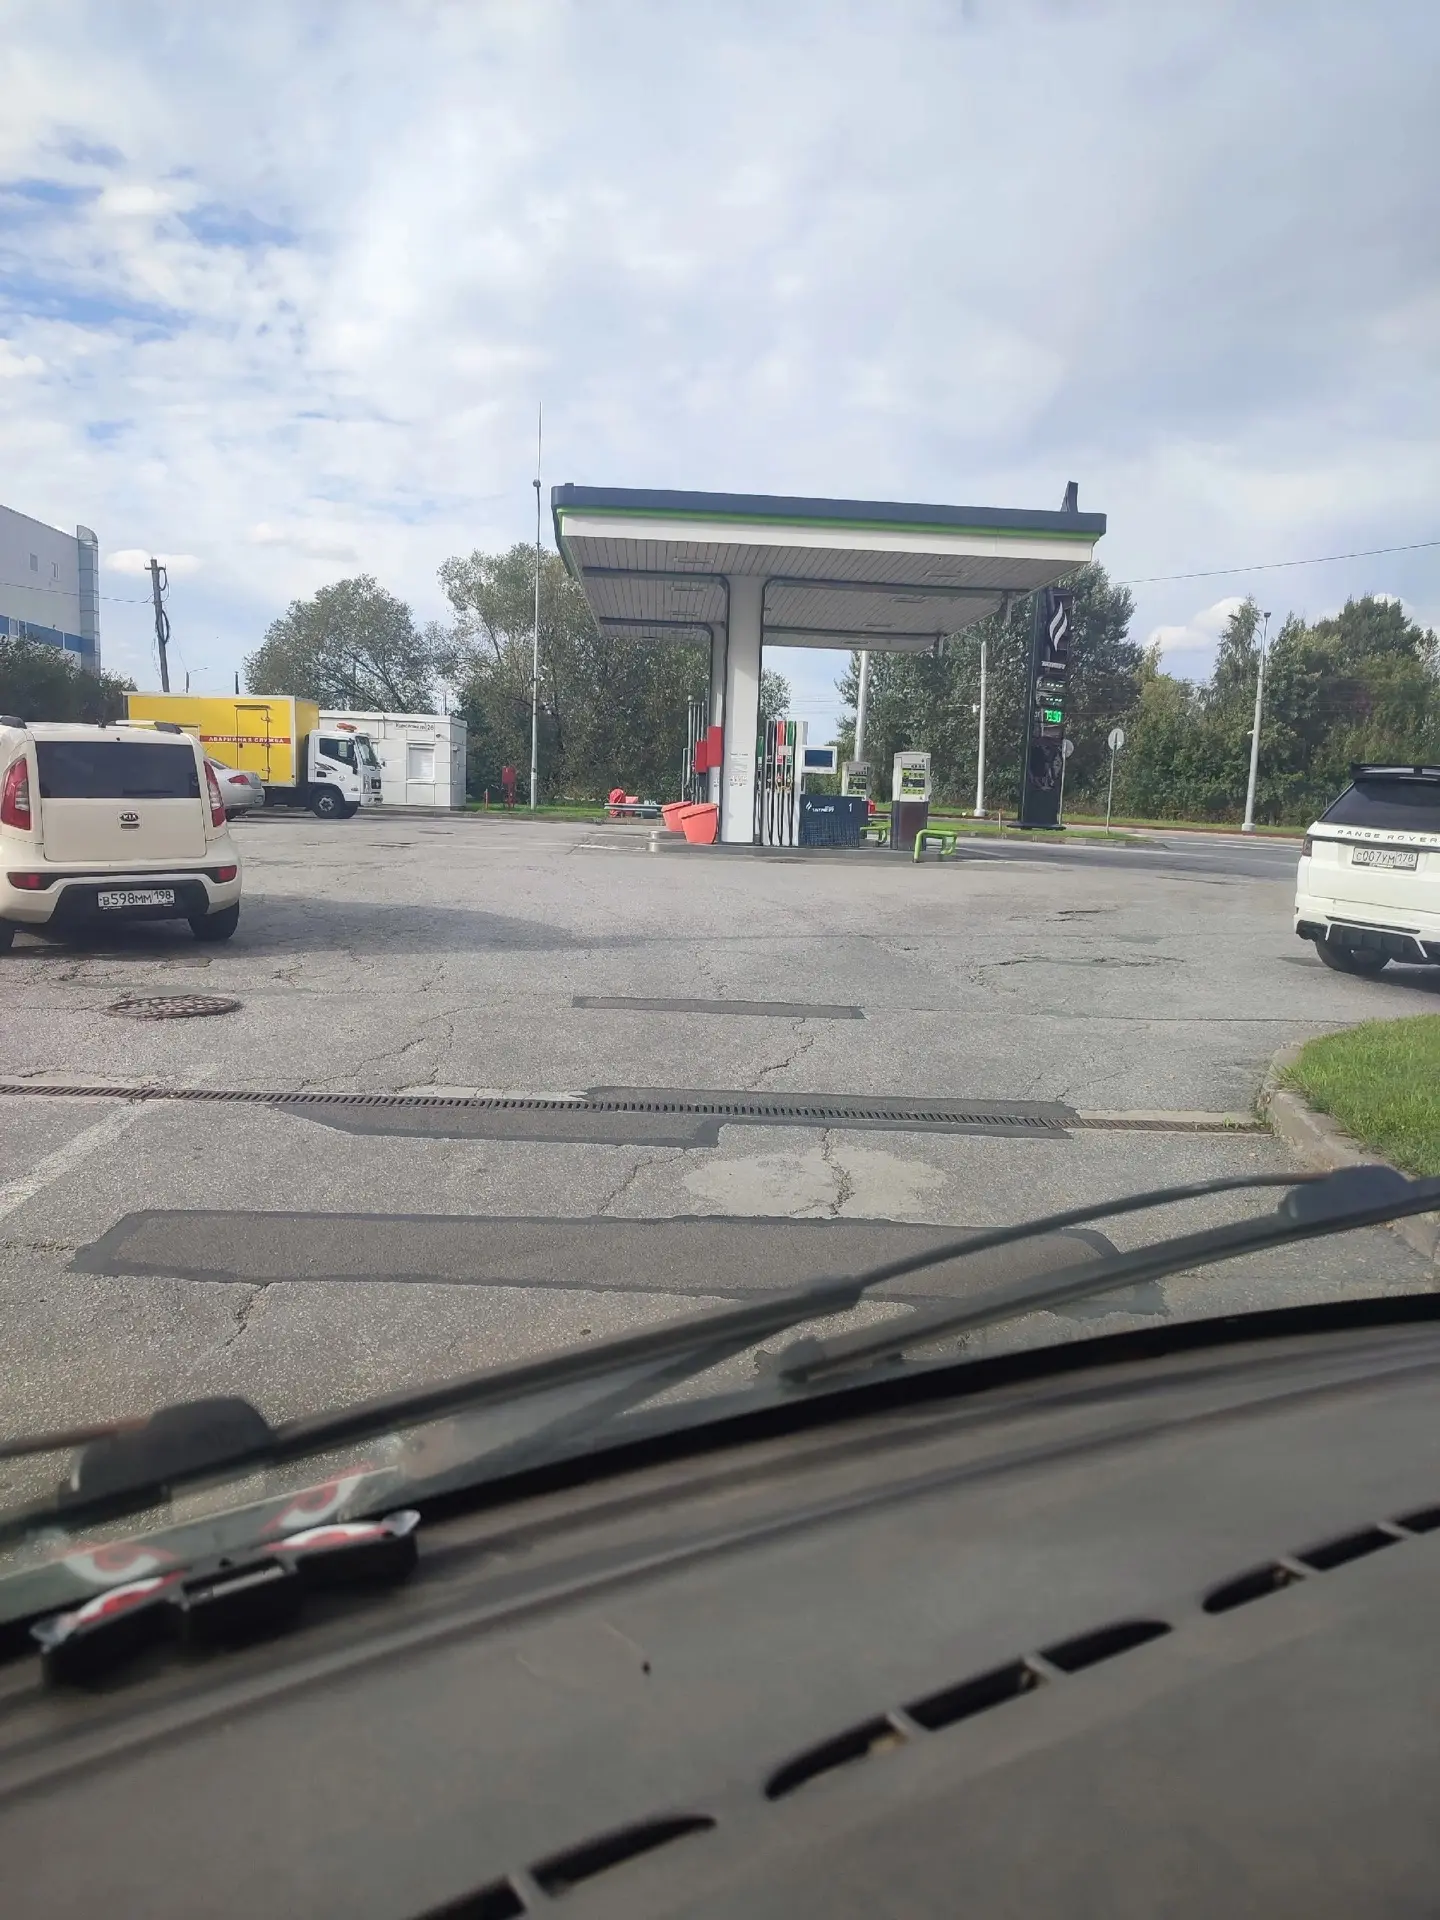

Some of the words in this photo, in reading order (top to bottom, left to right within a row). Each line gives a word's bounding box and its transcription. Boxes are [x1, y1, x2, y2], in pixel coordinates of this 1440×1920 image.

[848, 802, 853, 813] 1
[122, 813, 138, 821] KIA
[1337, 829, 1380, 838] RANGE
[1387, 834, 1438, 843] ROVER
